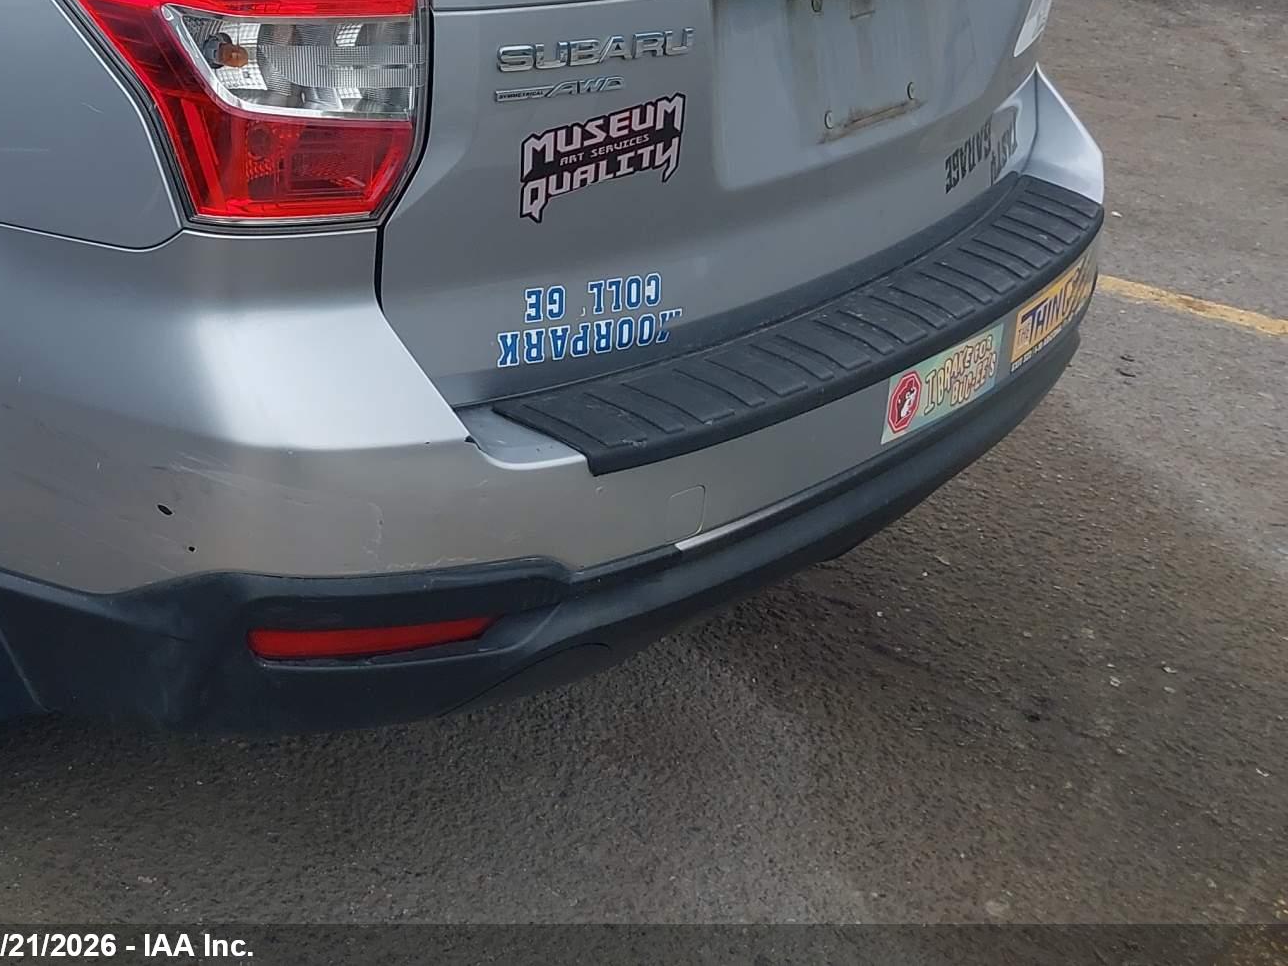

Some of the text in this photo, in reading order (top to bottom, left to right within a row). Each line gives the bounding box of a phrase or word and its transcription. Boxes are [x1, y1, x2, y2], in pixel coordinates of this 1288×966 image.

[497, 27, 695, 72] SUBARU
[544, 76, 625, 98] AWD
[522, 95, 684, 180] MUSEUM
[559, 133, 650, 167] ART SERVICES
[522, 136, 679, 221] QUALITY
[524, 272, 662, 323] COLLGE
[924, 369, 937, 416] I
[937, 345, 974, 406] BRAKE
[973, 334, 994, 364] FOR
